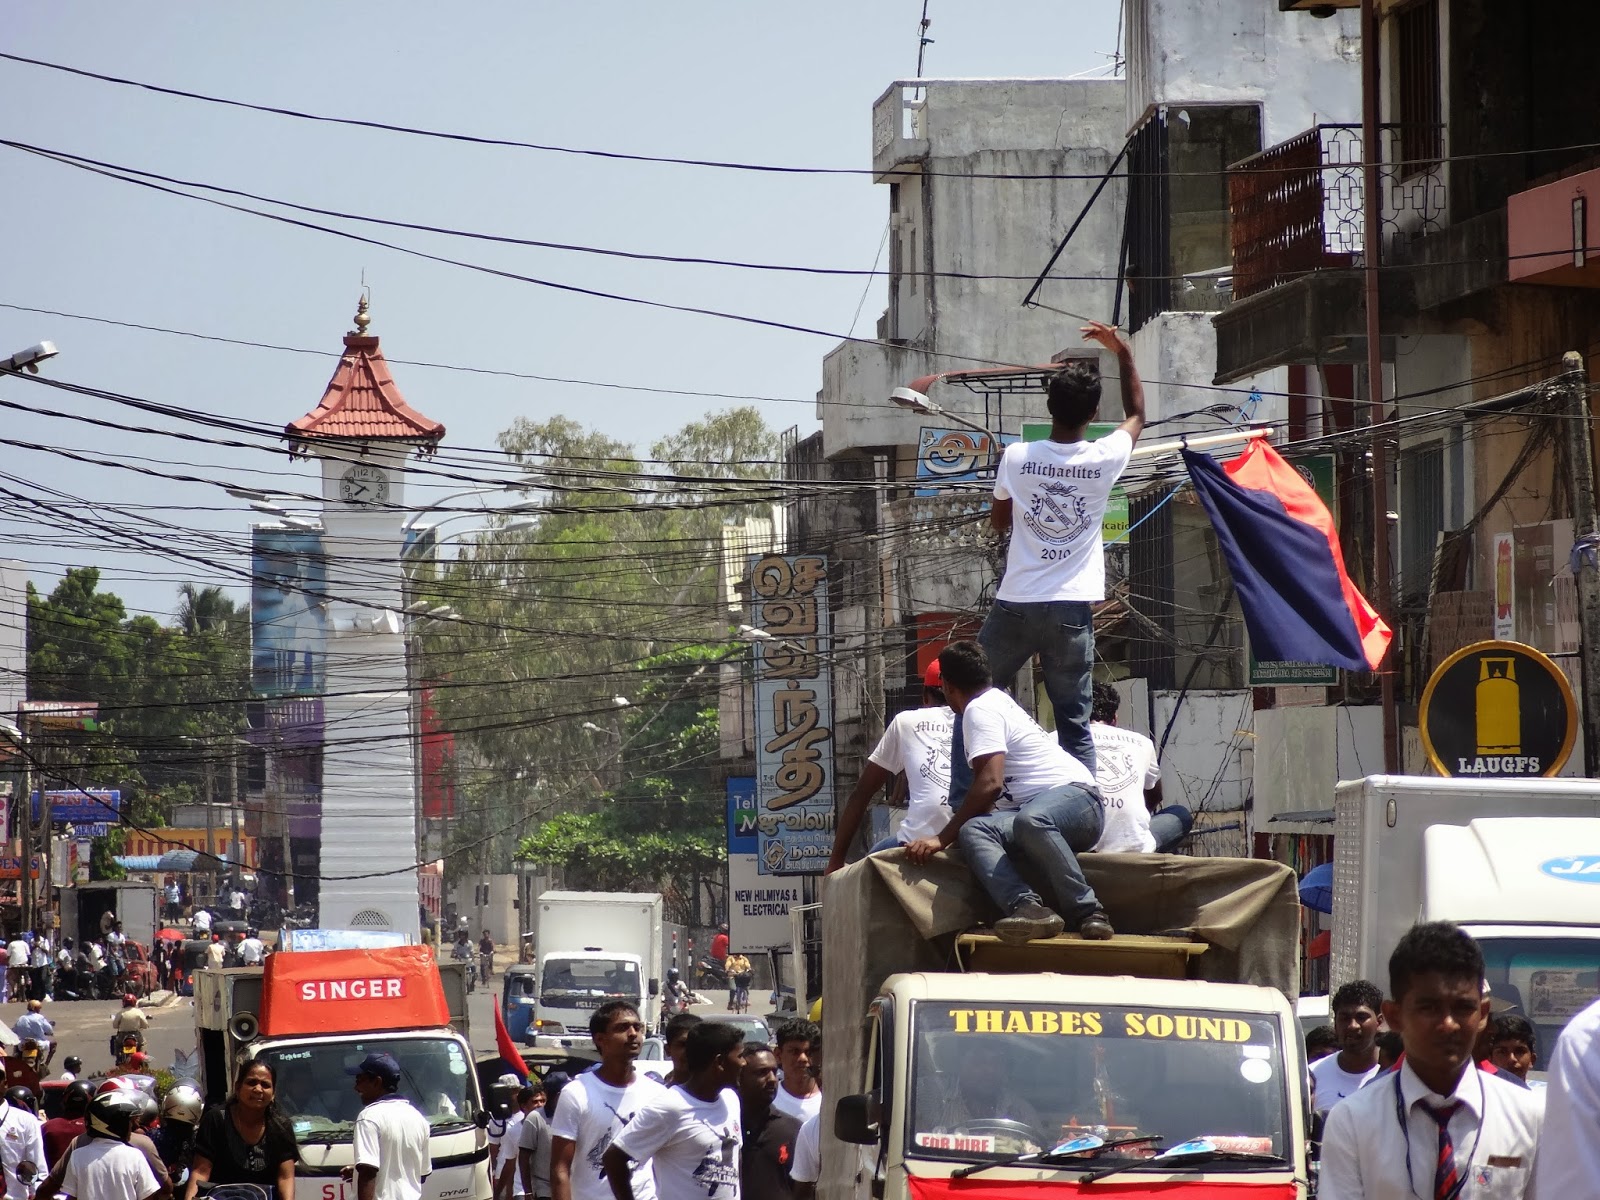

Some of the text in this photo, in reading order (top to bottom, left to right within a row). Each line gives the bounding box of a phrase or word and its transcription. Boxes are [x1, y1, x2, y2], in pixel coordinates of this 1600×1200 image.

[1019, 461, 1102, 479] Michaelites
[1101, 521, 1130, 530] icatio
[1041, 548, 1071, 560] 2010
[914, 720, 954, 733] Mich
[1094, 733, 1142, 747] haelites
[1458, 756, 1540, 773] LAUGFS
[50, 793, 113, 806] ENTS
[734, 795, 755, 809] Tel
[1103, 797, 1124, 809] 010
[74, 824, 107, 836] ARMACY
[735, 889, 798, 902] NEW HILMIYAS &
[301, 979, 403, 1000] SINGER
[949, 1009, 1252, 1043] THABES SOUND
[922, 1136, 989, 1152] FOR HIRE
[322, 1183, 346, 1200] SI
[439, 1187, 469, 1198] DYNA
